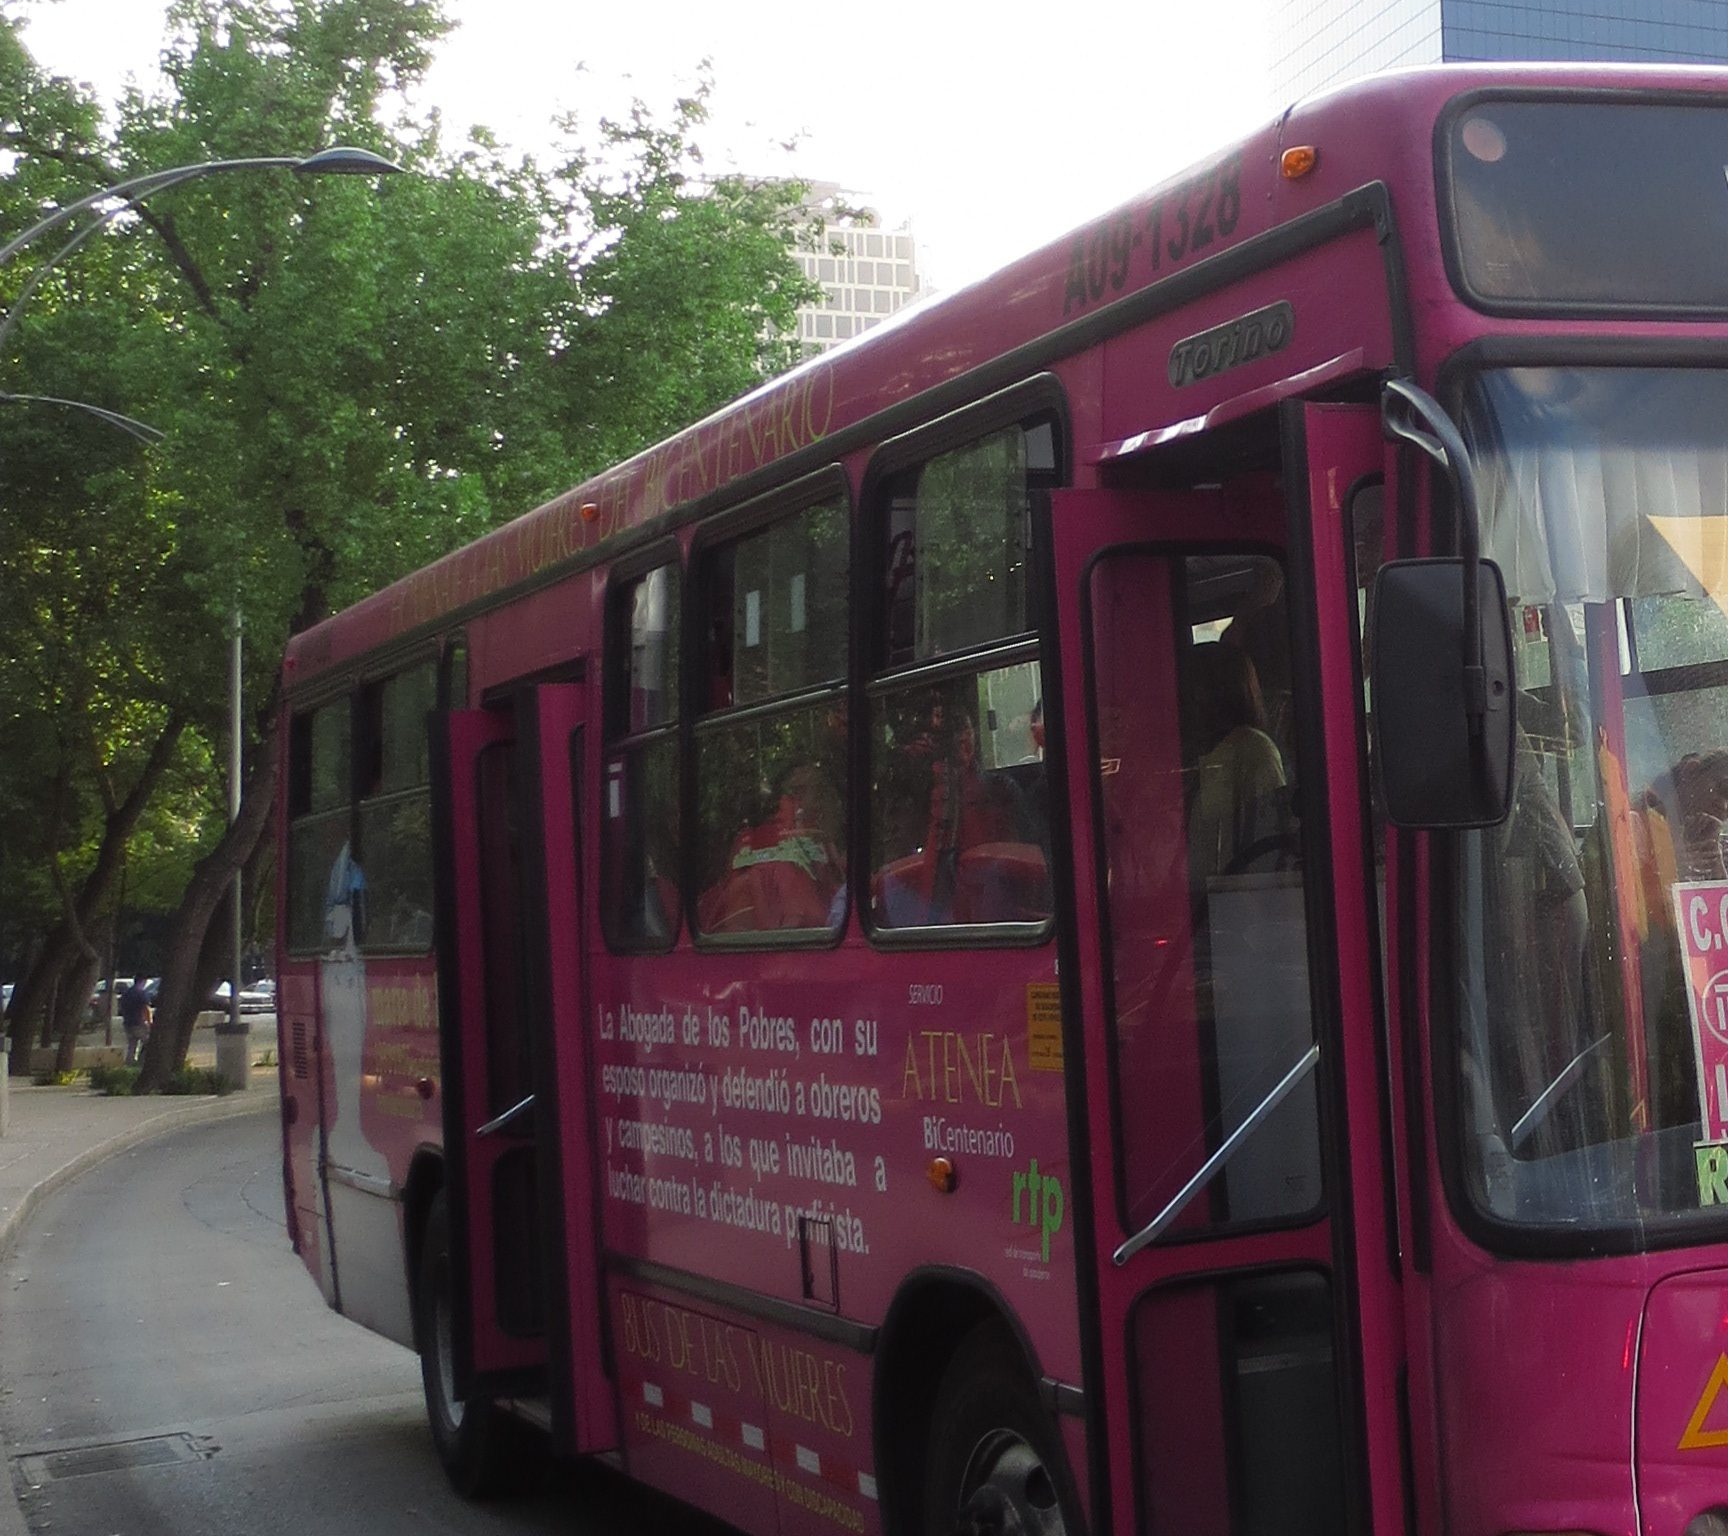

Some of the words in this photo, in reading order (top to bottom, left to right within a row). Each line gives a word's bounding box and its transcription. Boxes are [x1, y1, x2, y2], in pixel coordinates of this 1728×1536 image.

[1173, 314, 1286, 384] Torino
[908, 983, 943, 1005] SERVICIO
[599, 1004, 614, 1040] La
[620, 1004, 675, 1054] Abogada
[683, 1004, 700, 1045] de
[708, 1005, 730, 1045] los
[740, 1006, 799, 1061] Pobres,
[810, 1016, 843, 1054] con
[855, 1018, 878, 1056] su
[902, 1029, 1023, 1109] ATENEA
[602, 1063, 645, 1104] esposo
[649, 1061, 706, 1111] organizó
[709, 1074, 719, 1117] y
[722, 1066, 790, 1115] defendió
[795, 1080, 806, 1116] a
[810, 1072, 882, 1124] obreros
[604, 1117, 613, 1156] y
[618, 1115, 699, 1168] campesinos,
[704, 1130, 713, 1163] a
[719, 1123, 742, 1168] los
[749, 1138, 780, 1183] que
[786, 1131, 857, 1187] invitaba
[874, 1155, 887, 1193] a
[922, 1115, 1015, 1158] BiCentenario
[608, 1159, 646, 1204] luchar
[648, 1175, 691, 1216] contra
[692, 1177, 708, 1219] la
[709, 1180, 781, 1237] dictadura
[1012, 1158, 1064, 1264] rtp
[621, 1292, 660, 1363] BUS
[664, 1305, 698, 1376] DE
[699, 1316, 741, 1393] LAS
[744, 1331, 853, 1437] MUJERES
